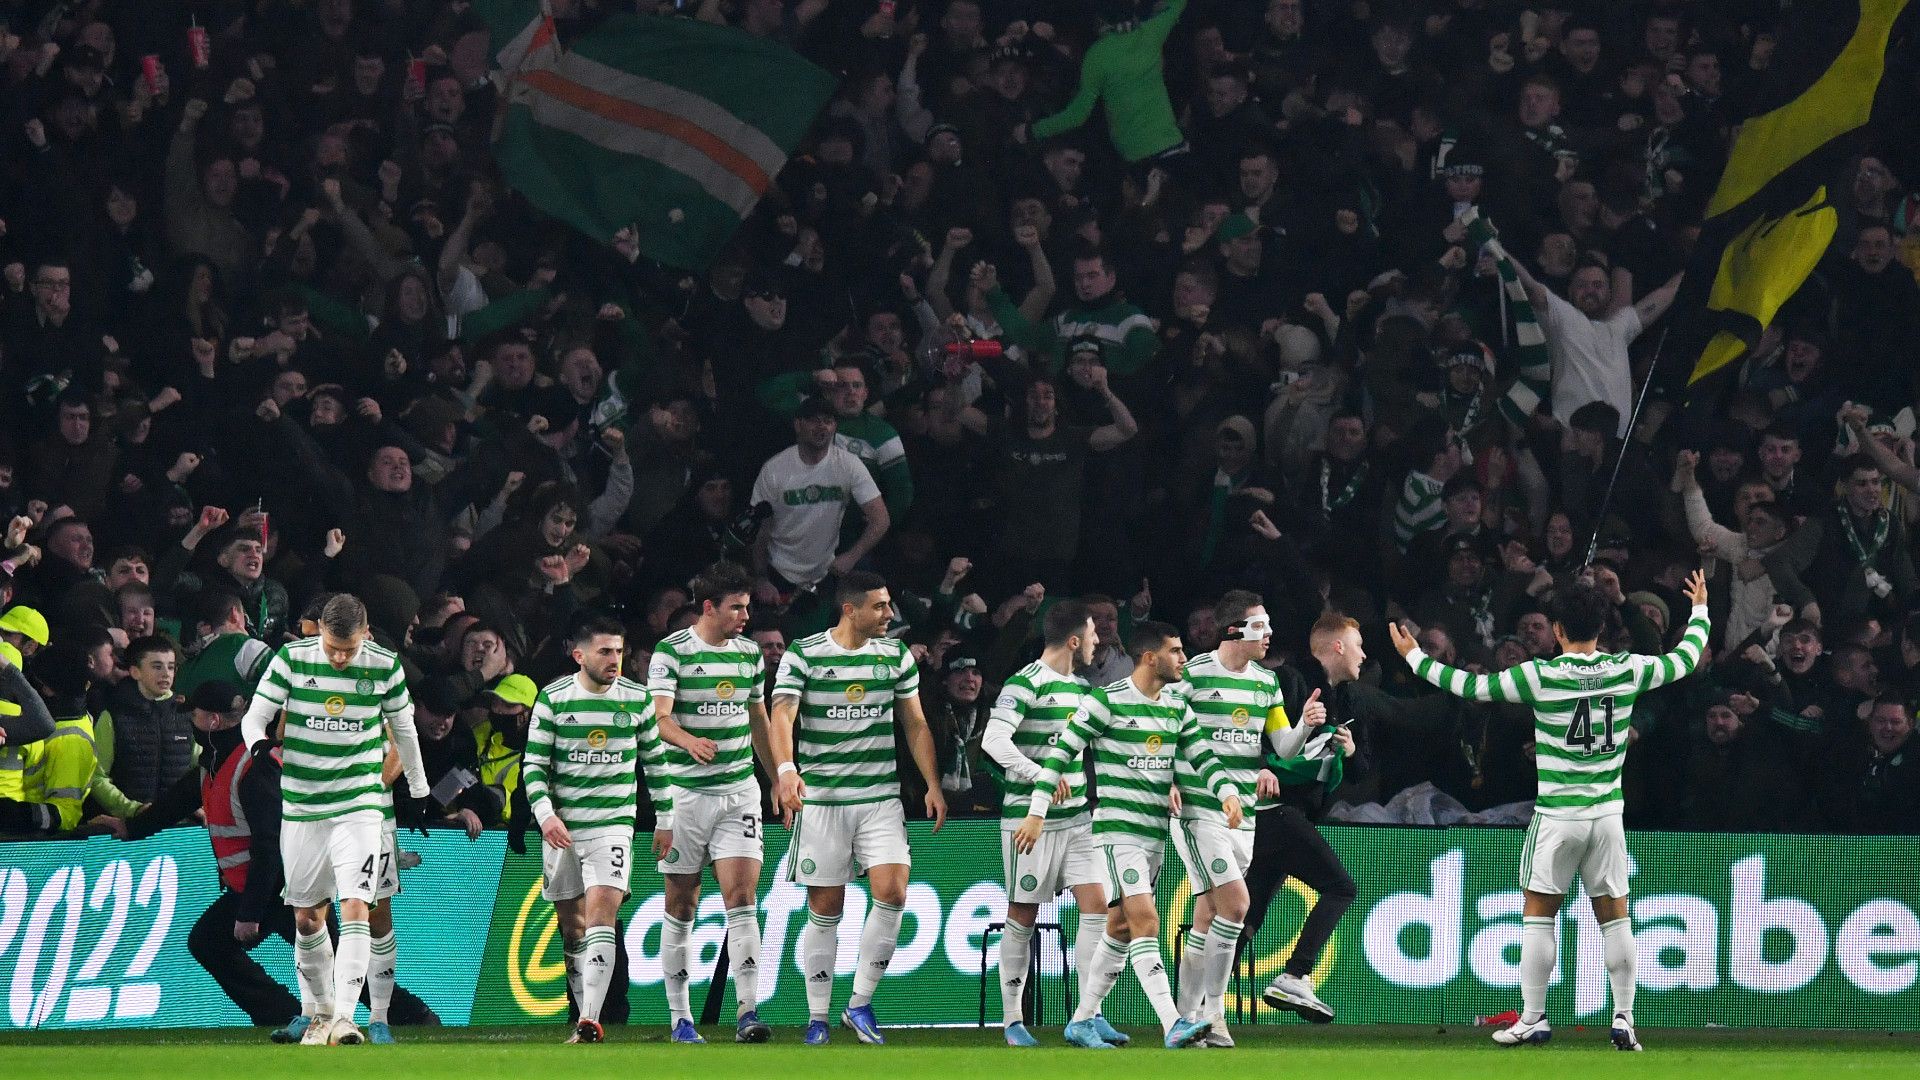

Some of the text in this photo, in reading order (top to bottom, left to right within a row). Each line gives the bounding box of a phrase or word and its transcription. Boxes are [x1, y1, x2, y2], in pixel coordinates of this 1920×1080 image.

[1560, 659, 1614, 673] MAGNERS
[1579, 678, 1604, 691] REO
[697, 702, 746, 716] dafabet
[826, 705, 883, 720] dafabet
[305, 716, 365, 732] dafabet
[1565, 695, 1617, 756] 41
[1212, 727, 1262, 744] dafabet
[567, 750, 623, 764] dafabet
[1127, 755, 1172, 770] dafabet
[611, 846, 624, 868] 3
